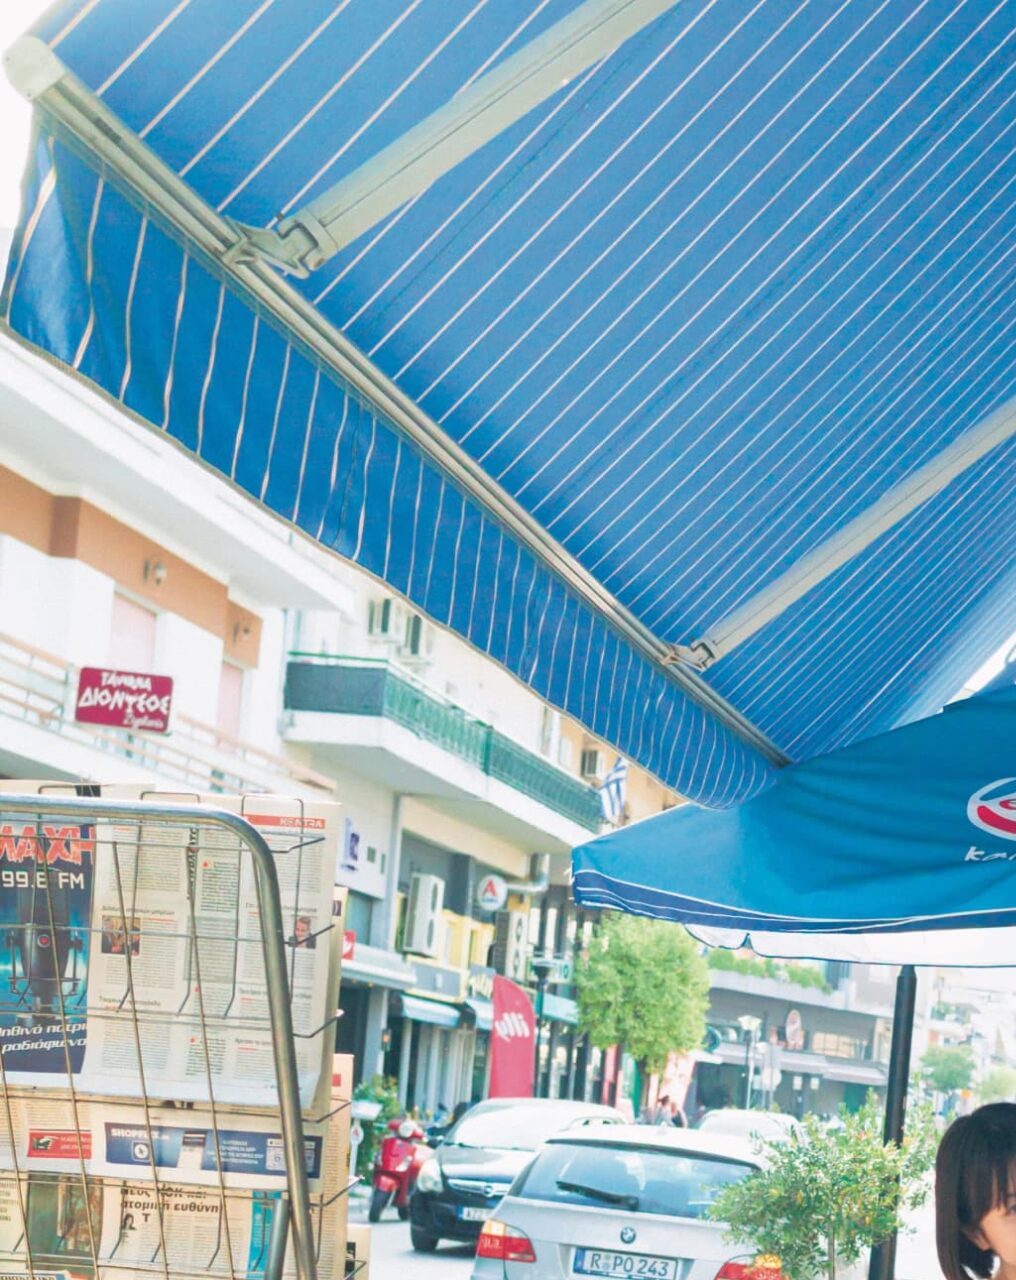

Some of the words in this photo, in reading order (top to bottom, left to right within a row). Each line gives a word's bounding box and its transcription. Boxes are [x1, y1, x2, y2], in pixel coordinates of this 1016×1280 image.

[58, 872, 85, 890] FM
[174, 1201, 219, 1214] ευθύνη
[590, 1253, 602, 1270] R
[612, 1255, 634, 1273] PO
[636, 1259, 669, 1277] 243
